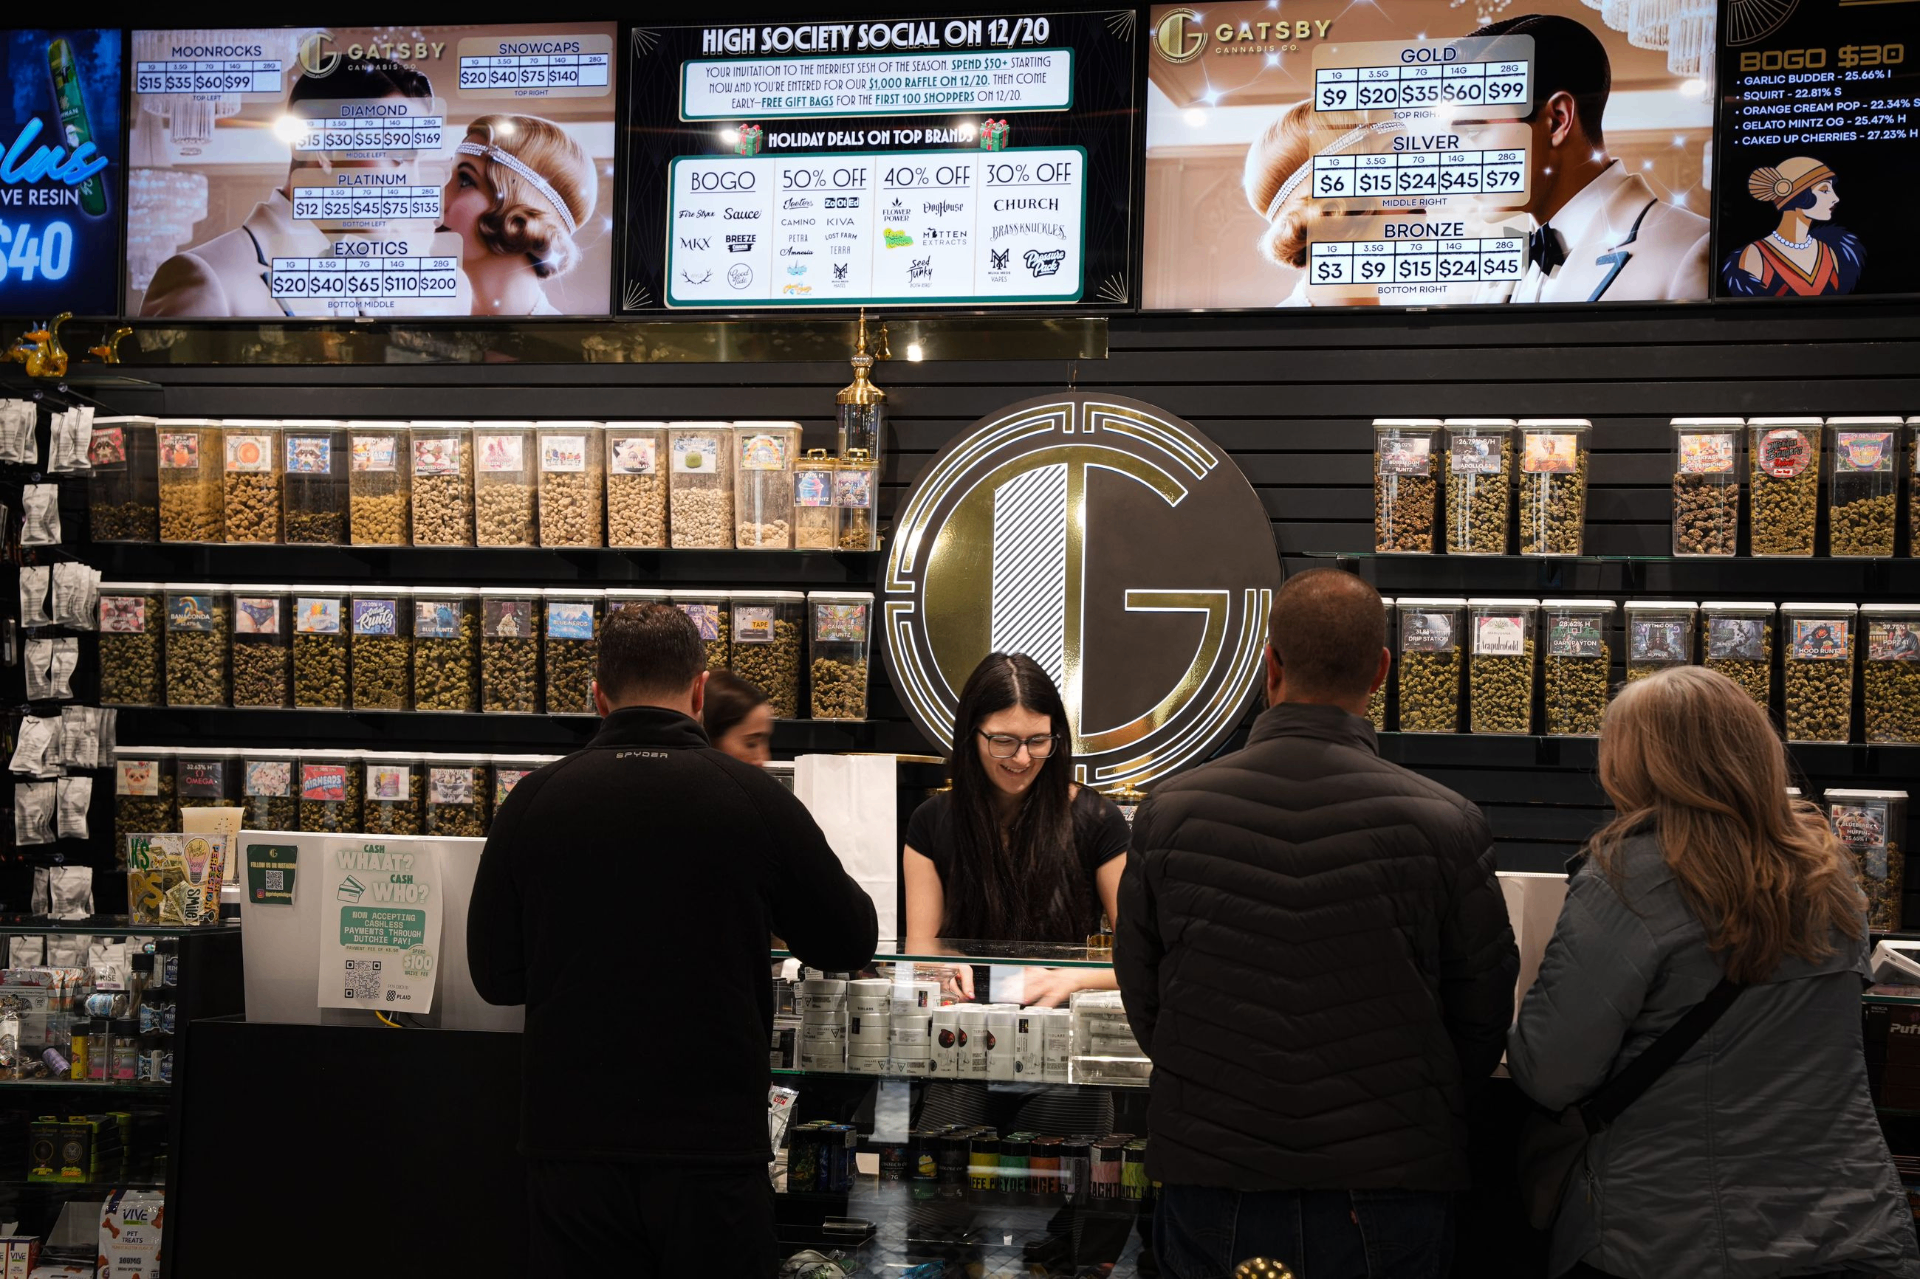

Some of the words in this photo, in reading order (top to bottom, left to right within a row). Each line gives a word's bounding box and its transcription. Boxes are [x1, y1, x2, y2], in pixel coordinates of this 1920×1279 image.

[703, 27, 756, 55] HIGH
[761, 24, 853, 53] SOCIETY
[857, 20, 939, 50] SOCIAL
[944, 19, 982, 47] ON
[988, 17, 1049, 49] 12/20
[1215, 19, 1331, 42] GATSBY
[172, 45, 262, 58] MOONROCKS
[499, 42, 580, 55] SNOWCAPS
[1215, 44, 1275, 54] CANNABIS
[1282, 44, 1300, 52] CO.
[1401, 47, 1456, 63] GOLD
[1740, 48, 1826, 72] BOGO
[1838, 44, 1904, 68] $30
[706, 66, 731, 78] YOUR
[733, 64, 781, 77] INVITATION
[784, 64, 798, 76] TO
[800, 63, 814, 75] THE
[816, 62, 854, 74] MERRIEST
[858, 62, 875, 73] SESH
[879, 61, 893, 73] OF
[895, 60, 910, 72] THE
[912, 59, 948, 72] SEASON.
[951, 59, 982, 70] SPEND
[984, 57, 1007, 70] $50+
[1011, 56, 1051, 68] STARTING
[1368, 70, 1389, 78] 3.5G
[1415, 68, 1428, 76] 7G
[1451, 66, 1467, 75] 14G
[1500, 64, 1519, 73] 28G
[461, 71, 487, 85] $20
[490, 71, 517, 84] $40
[520, 70, 545, 83] $75
[549, 70, 577, 83] $140
[709, 82, 732, 93] NOW
[735, 82, 751, 93] AND
[754, 81, 784, 92] YOU'RE
[788, 80, 821, 91] ENTERED
[824, 79, 843, 90] FOR
[845, 79, 866, 90] OUR
[869, 77, 902, 90] $1,000
[905, 76, 938, 88] RAFFLE
[940, 76, 957, 86] ON
[993, 74, 1013, 85] THEN
[1016, 73, 1047, 84] COME
[1744, 74, 1786, 86] GARLIC
[1788, 72, 1834, 84] BUDDER
[1845, 69, 1885, 81] 25.66%
[785, 97, 806, 107] GIFT
[809, 95, 834, 106] BAGS
[836, 95, 856, 106] FOR
[859, 94, 872, 105] THE
[875, 94, 899, 105] FIRST
[903, 93, 921, 104] 100
[924, 92, 975, 103] SHOPPERS
[977, 91, 994, 102] ON
[996, 90, 1022, 101] 12/20.
[1323, 88, 1347, 107] $9
[1359, 87, 1397, 106] $20
[1402, 85, 1439, 104] $35
[1443, 84, 1481, 101] $60
[1489, 82, 1524, 100] $99
[1744, 90, 1785, 101] SQUIRT
[1795, 87, 1832, 98] 22.81%
[1834, 87, 1842, 97] S
[341, 105, 408, 117] DIAMOND
[1743, 105, 1791, 116] ORANGE
[1793, 103, 1833, 113] CREAM
[1836, 101, 1860, 111] POP
[1870, 99, 1910, 110] 22.34%
[1742, 120, 1786, 130] GELATO
[1788, 118, 1824, 128] MINTZ
[1826, 117, 1844, 127] OG
[1854, 115, 1894, 125] 25.47%
[1898, 114, 1907, 123] H
[769, 132, 826, 147] HOLIDAY
[828, 131, 864, 146] DEALS
[867, 130, 890, 145] ON
[893, 129, 922, 144] TOP
[925, 127, 974, 143] BRANDS
[1393, 134, 1459, 151] SILVER
[1742, 135, 1781, 146] CAKED
[1783, 134, 1799, 144] UP
[1801, 132, 1857, 143] CHERRIES
[1867, 130, 1907, 140] 27.23%
[1909, 129, 1919, 138] H
[338, 174, 406, 187] PLATINUM
[692, 171, 755, 191] BOGO
[783, 169, 826, 188] 50%
[832, 168, 867, 188] OFF
[884, 167, 929, 186] 40%
[936, 166, 970, 185] OFF
[987, 164, 1030, 183] 30%
[1036, 163, 1071, 182] OFF
[29, 189, 79, 206] RESIN
[994, 198, 1059, 212] CHURCH
[723, 207, 762, 220] Sauce
[781, 218, 816, 226] CAMINO
[826, 217, 855, 226] KIVA
[1384, 222, 1464, 238] BRONZE
[726, 234, 756, 243] BREEZE
[789, 234, 808, 242] PETRA
[922, 238, 967, 246] EXTRACTS
[335, 241, 408, 256] EXOTICS
[1318, 262, 1343, 280] $3
[1361, 261, 1385, 279] $9
[1399, 260, 1431, 277] $15
[1439, 259, 1477, 277] $24
[1484, 258, 1518, 275] $45
[274, 278, 306, 294] $20
[310, 278, 344, 294] $40
[348, 277, 380, 293] $65
[384, 277, 417, 292] $110
[420, 276, 456, 291] $200
[364, 844, 385, 854] CASH
[390, 874, 413, 885] CASH
[372, 882, 430, 904] WHO?
[364, 920, 404, 929] CASHLESS
[372, 912, 416, 922] ACCEPTING
[344, 927, 384, 936] PAYMENTS
[389, 929, 421, 938] THROUGH
[354, 935, 388, 944] DUTCHIE
